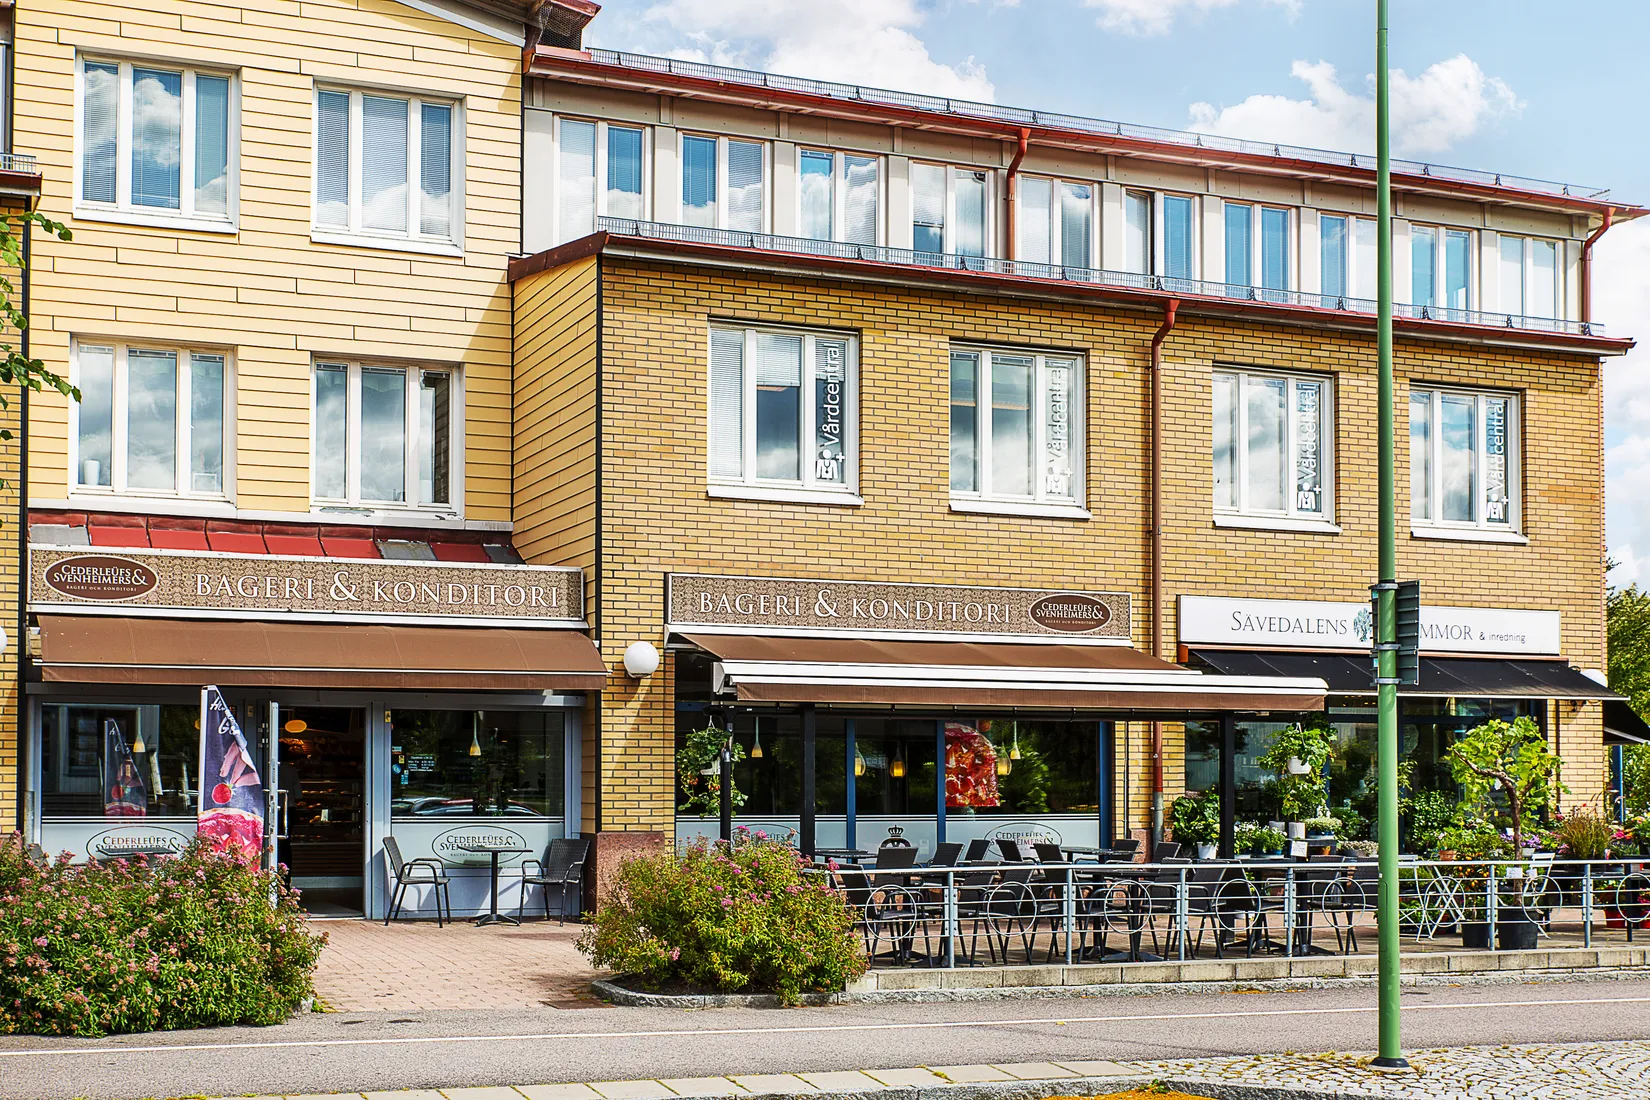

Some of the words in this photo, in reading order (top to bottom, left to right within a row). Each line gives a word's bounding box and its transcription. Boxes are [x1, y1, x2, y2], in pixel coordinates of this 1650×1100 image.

[822, 343, 840, 446] Vårdcentral
[53, 572, 131, 585] SVENHEIMERS
[131, 568, 149, 586] &
[61, 565, 131, 577] CEDERLEÜFS
[195, 573, 314, 599] BAGERI
[329, 571, 360, 602] &
[373, 580, 559, 608] KONDITORI
[699, 592, 801, 616] BAGERI
[814, 589, 842, 618] &
[851, 598, 1010, 623] KONDITORI
[1036, 608, 1092, 619] SVENHEIMERS
[1092, 605, 1105, 620] &
[1041, 602, 1092, 612] CEDERLEÜFS
[1231, 610, 1348, 635] SÄVEDALENS
[1419, 623, 1473, 640] MMOR
[1478, 631, 1486, 641] &
[1488, 632, 1526, 644] inredning
[102, 836, 167, 845] CEDERLEÜFS
[446, 835, 504, 844] CEDERLEÜFS
